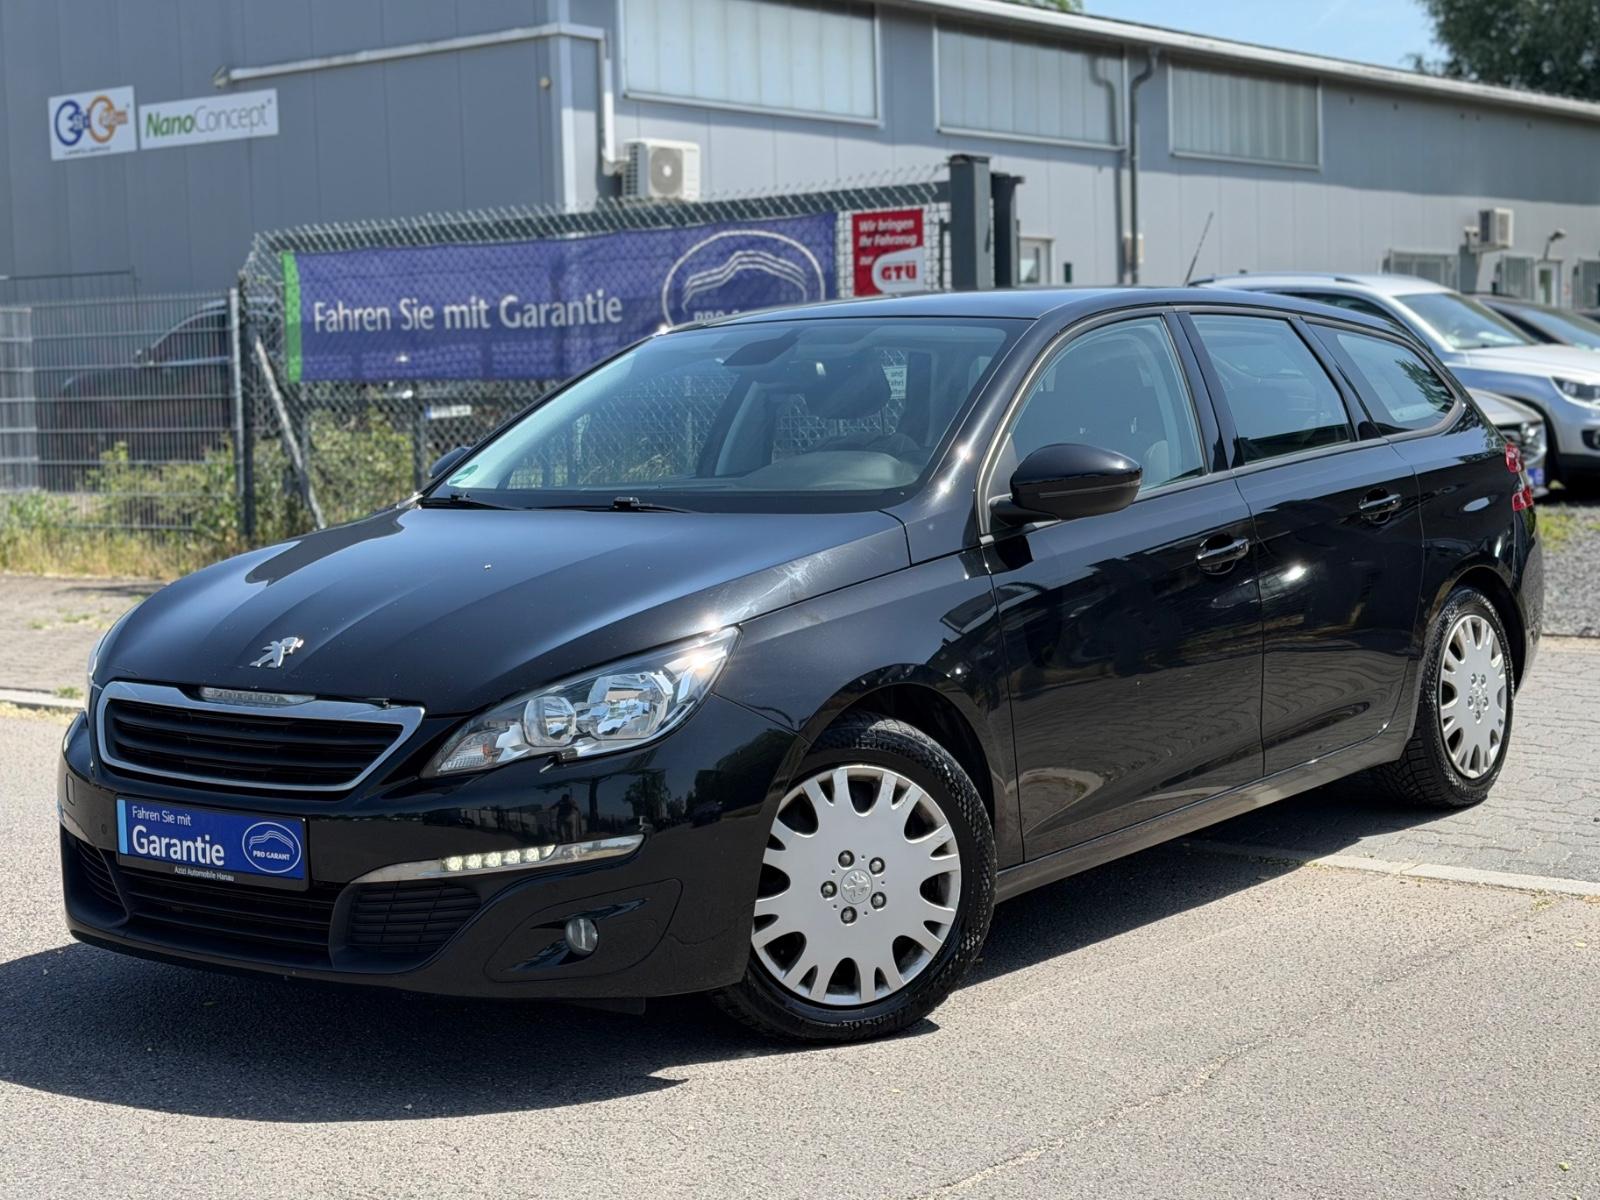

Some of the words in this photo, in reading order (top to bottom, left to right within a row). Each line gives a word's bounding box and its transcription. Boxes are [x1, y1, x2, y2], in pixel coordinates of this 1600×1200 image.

[145, 103, 268, 138] NanoConcept
[859, 220, 876, 232] Wir
[878, 218, 914, 231] bringen
[859, 235, 874, 247] Ihr
[874, 233, 917, 247] Fahrzeug
[314, 302, 391, 333] Fahren
[400, 298, 434, 330] Sie
[443, 296, 490, 329] mit
[500, 289, 623, 329] Garantie
[132, 806, 160, 822] Fahren
[162, 810, 174, 824] Sie
[177, 813, 191, 826] mit
[132, 825, 225, 866] Garantie
[253, 850, 265, 858] PRO
[266, 852, 290, 861] GARANT
[188, 868, 216, 879] Automobile
[217, 873, 235, 881] Hanau
